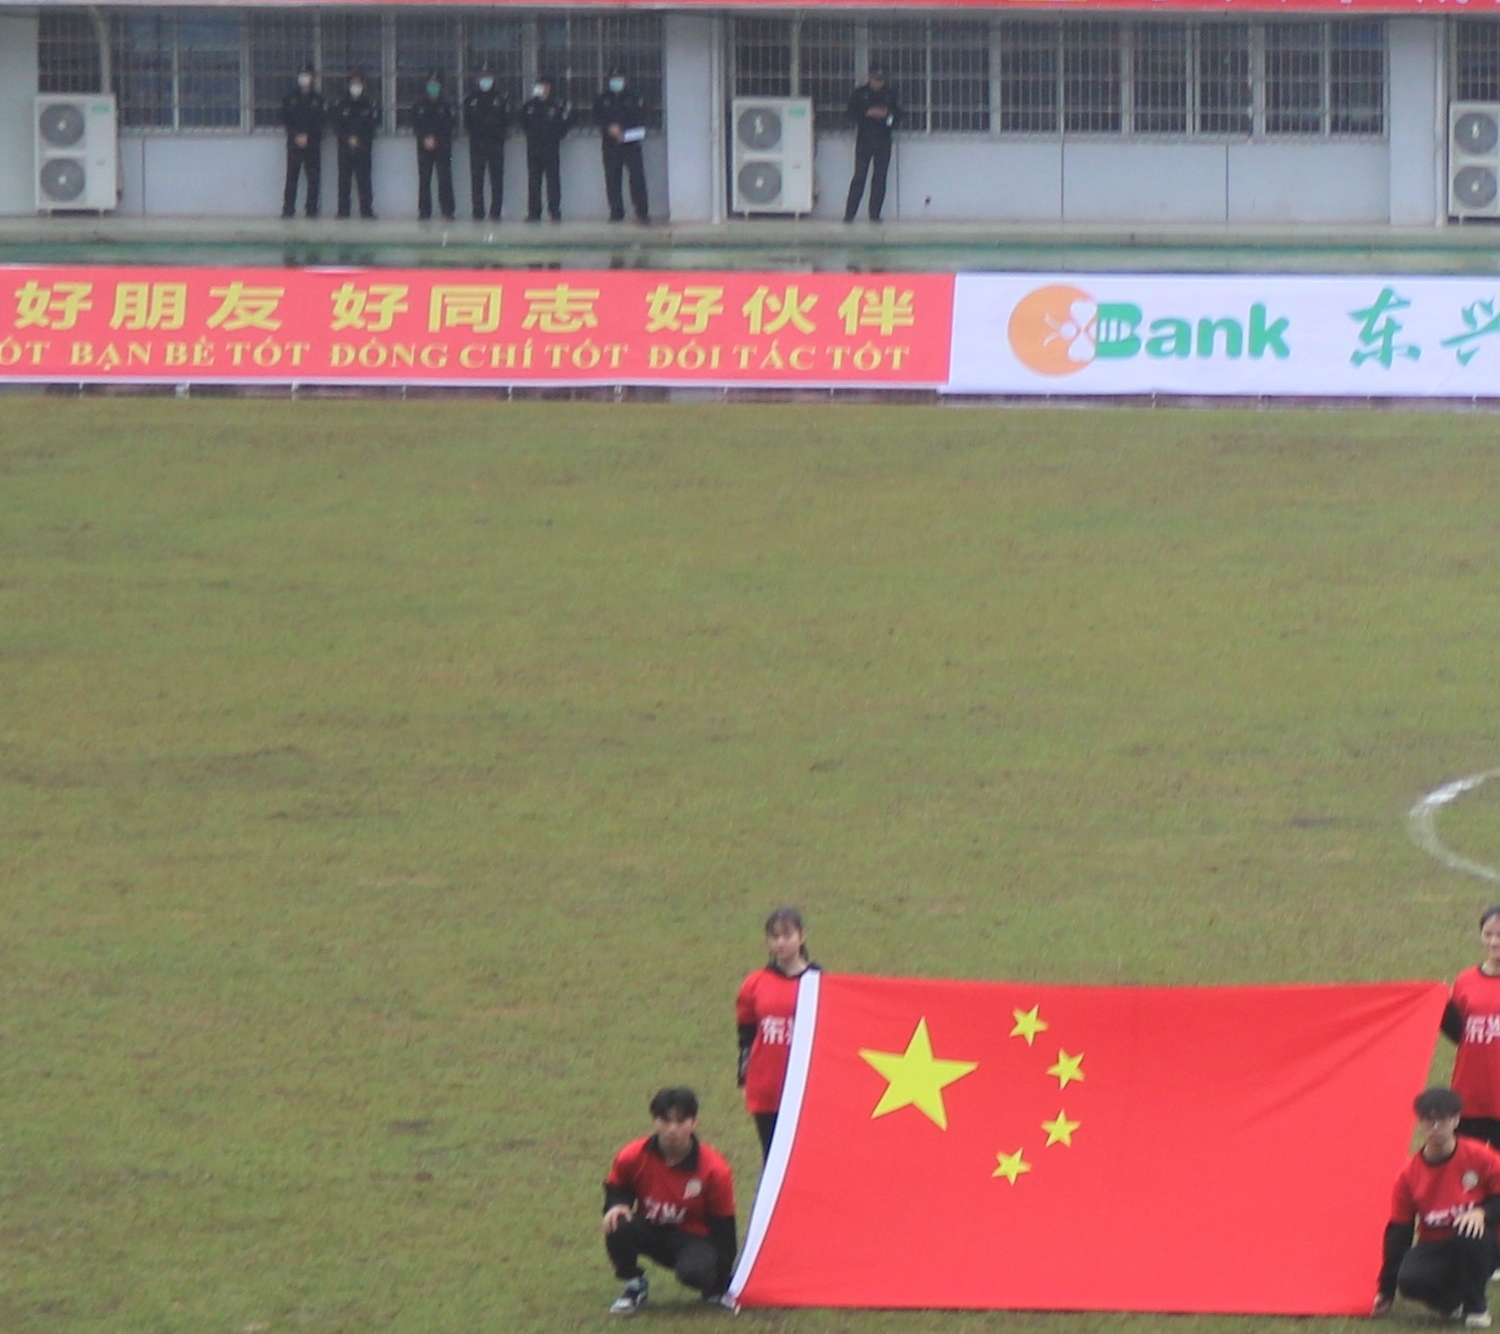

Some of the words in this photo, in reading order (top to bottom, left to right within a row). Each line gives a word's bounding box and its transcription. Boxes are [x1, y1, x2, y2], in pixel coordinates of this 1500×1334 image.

[15, 281, 286, 332] 好朋友
[331, 283, 601, 334] 好同志
[646, 285, 916, 337] 好伙伴
[1094, 302, 1292, 361] Bank
[0, 336, 50, 366] ỐT
[459, 338, 533, 369] CHÍ
